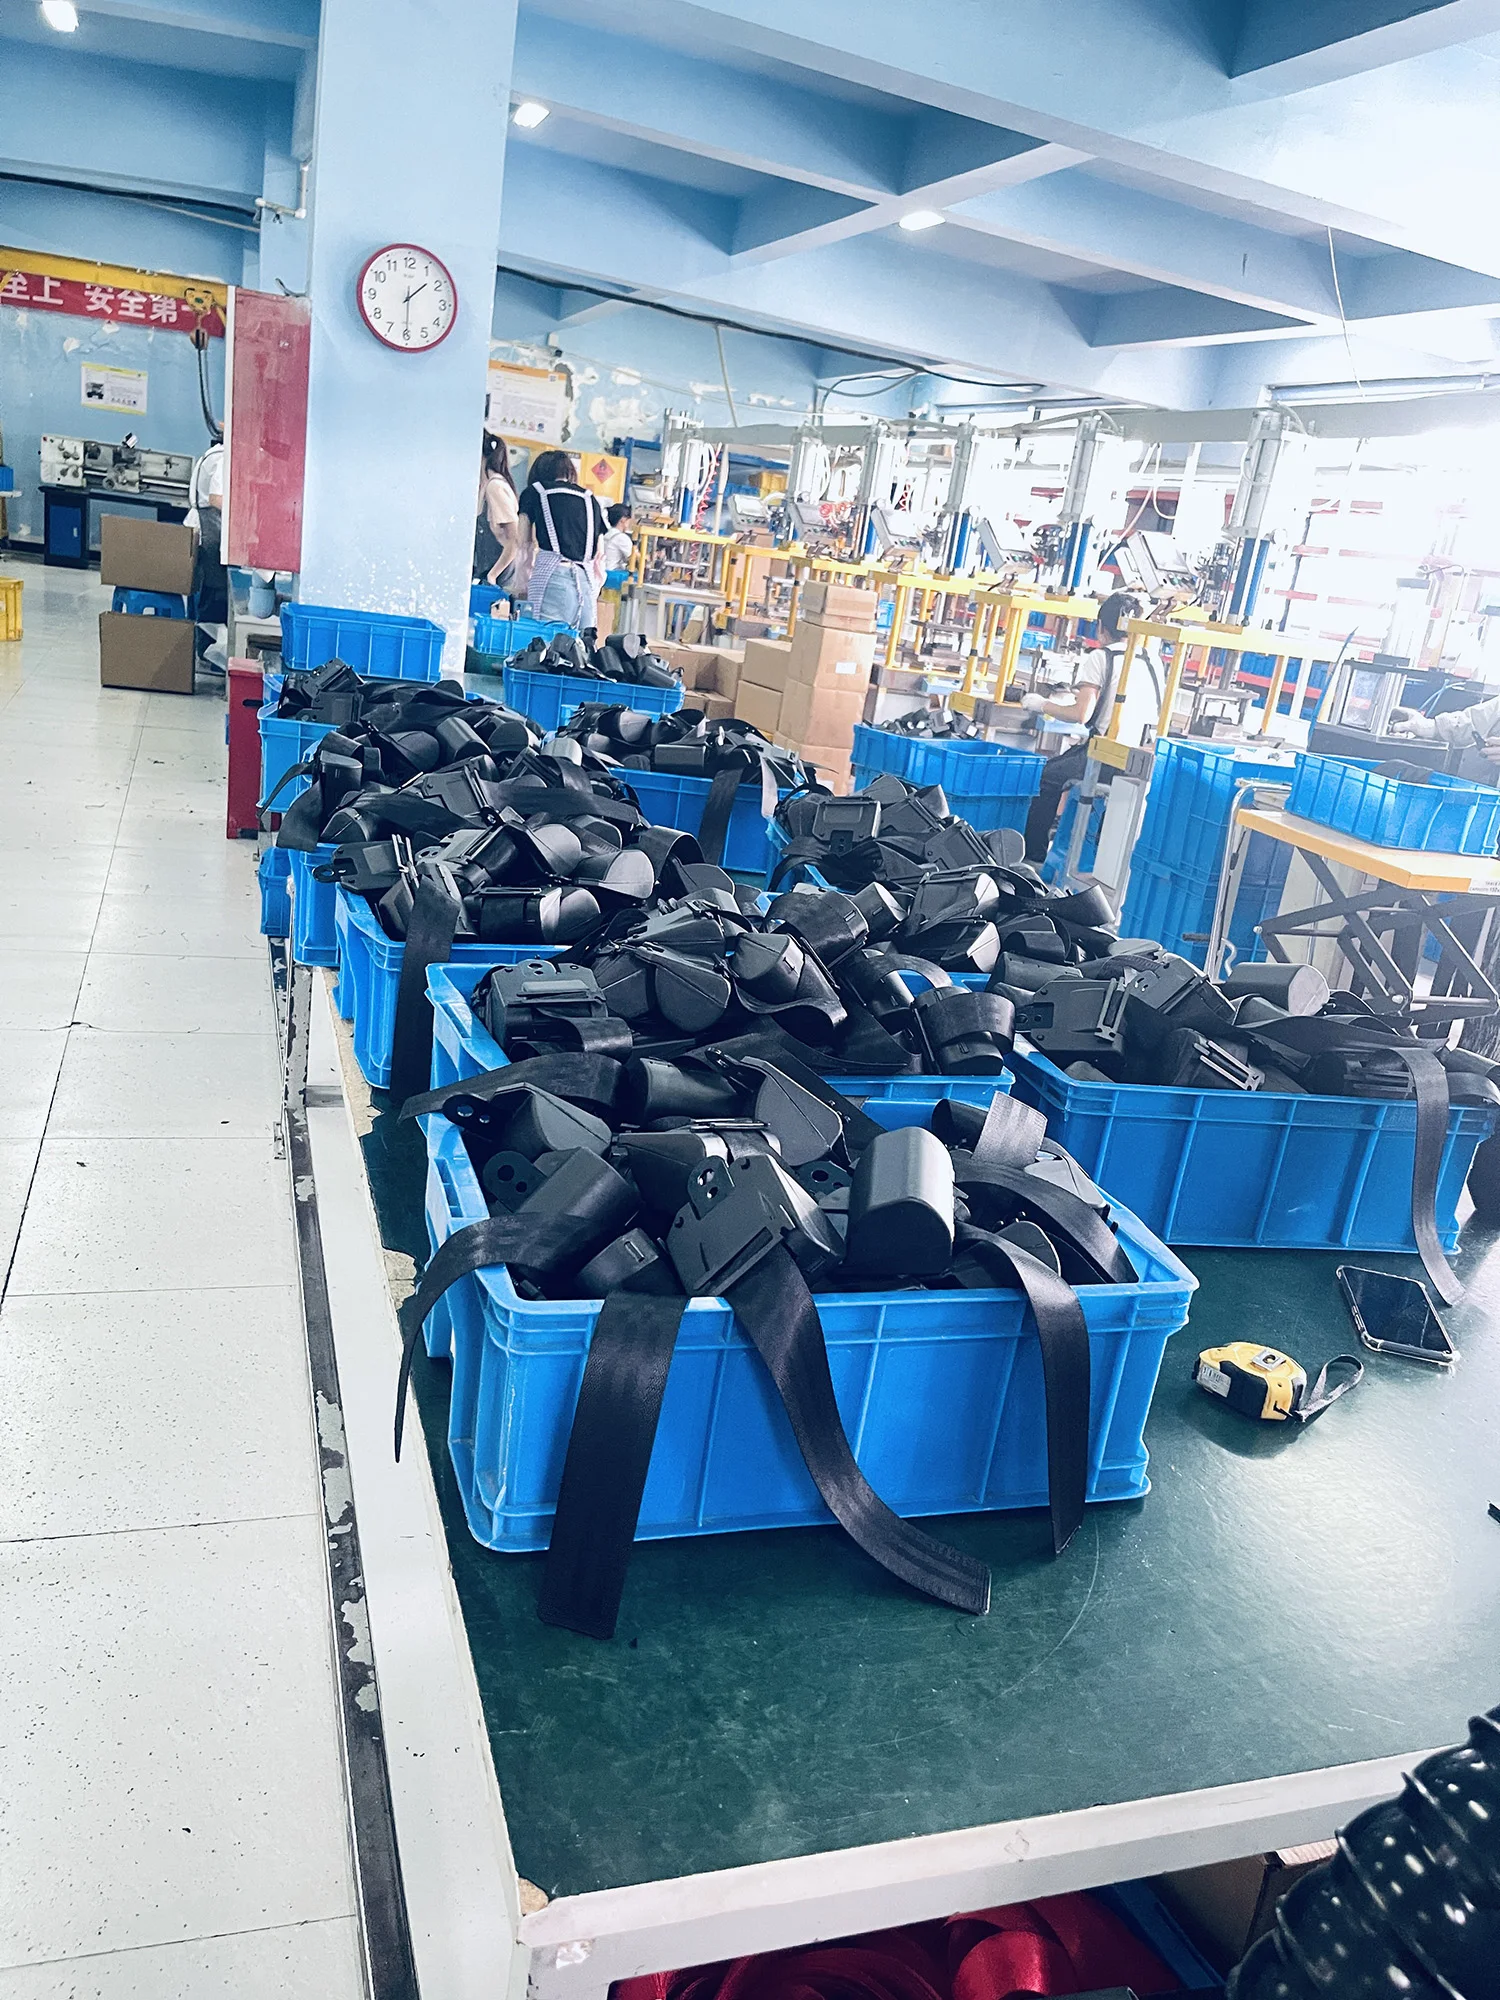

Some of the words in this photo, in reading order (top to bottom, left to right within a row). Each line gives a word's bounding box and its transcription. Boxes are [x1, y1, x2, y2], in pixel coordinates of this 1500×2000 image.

[387, 260, 397, 272] 11
[404, 257, 416, 270] 12
[374, 270, 386, 283] 10
[424, 265, 429, 277] 1
[434, 279, 443, 292] 2
[368, 287, 377, 300] 9
[438, 299, 447, 312] 3
[373, 307, 382, 320] 8
[386, 321, 395, 333] 7
[432, 317, 441, 328] 4
[402, 328, 411, 341] 6
[420, 327, 429, 339] 5
